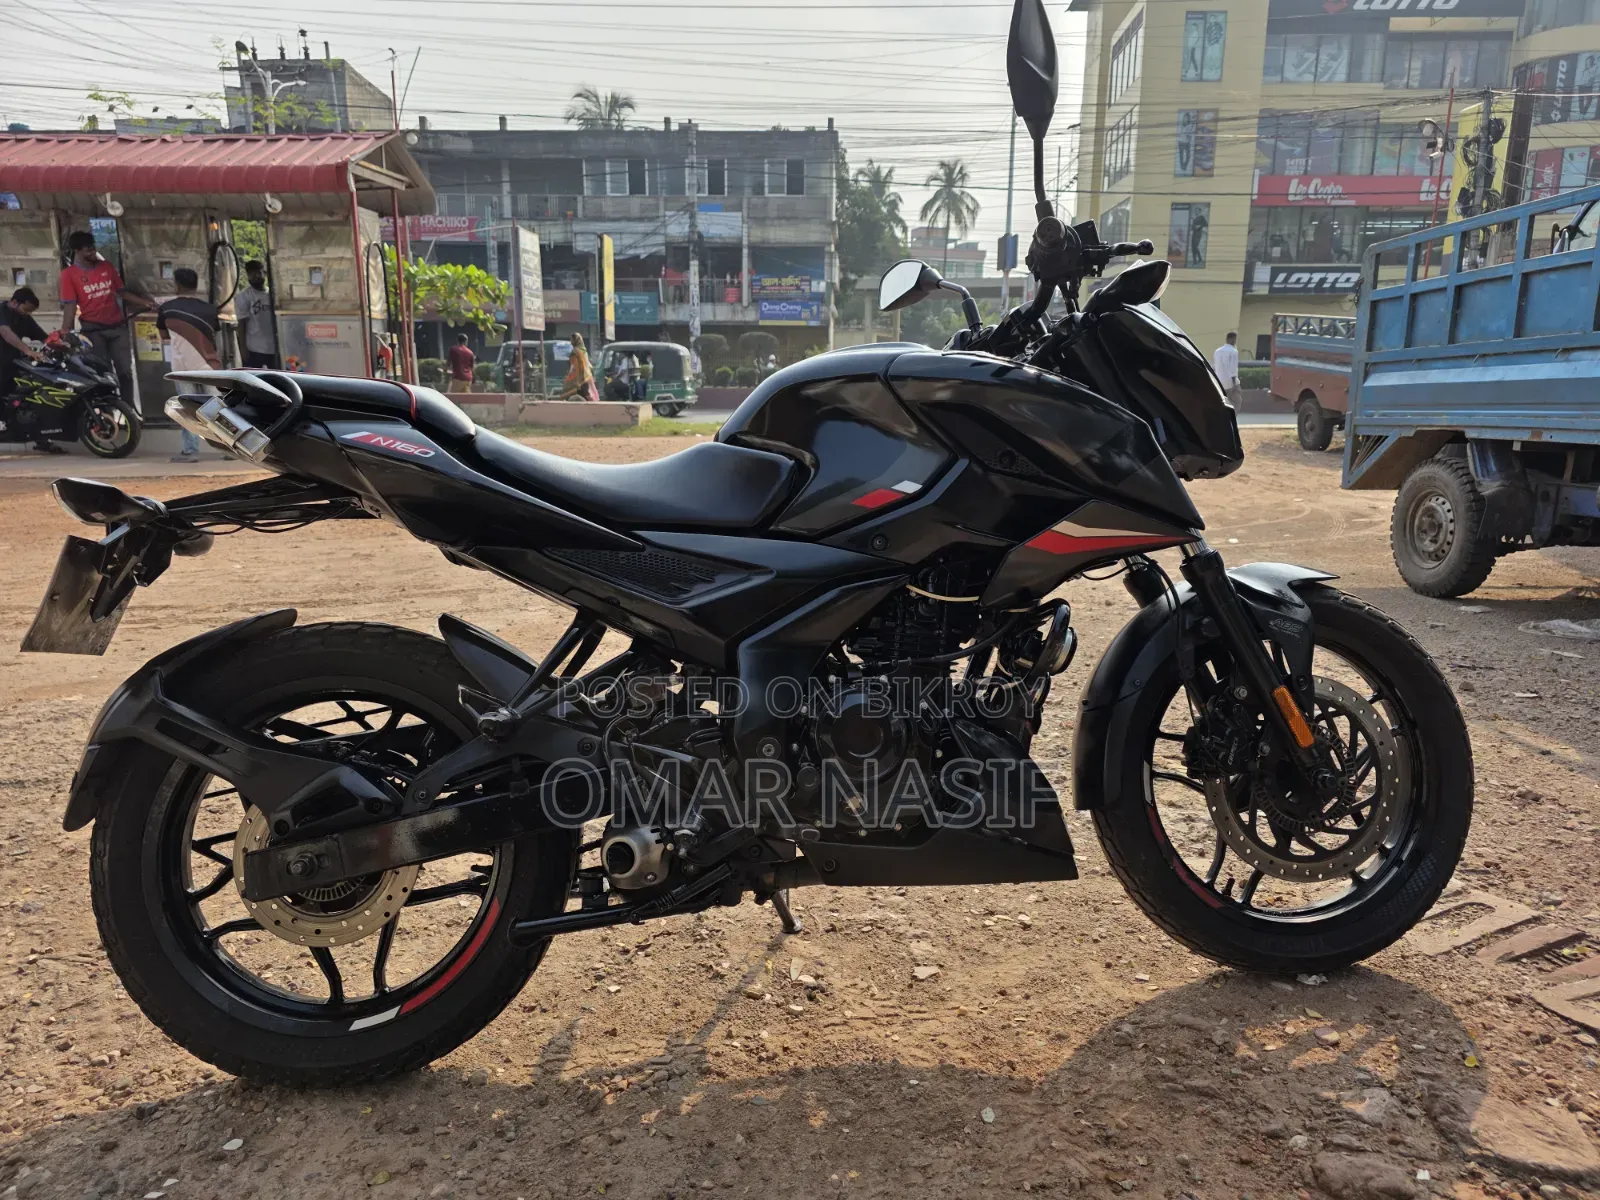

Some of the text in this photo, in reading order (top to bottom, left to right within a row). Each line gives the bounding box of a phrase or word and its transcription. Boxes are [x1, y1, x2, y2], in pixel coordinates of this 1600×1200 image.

[420, 216, 469, 228] HACHIKO
[1272, 272, 1361, 288] LOTTO
[370, 436, 436, 457] N160
